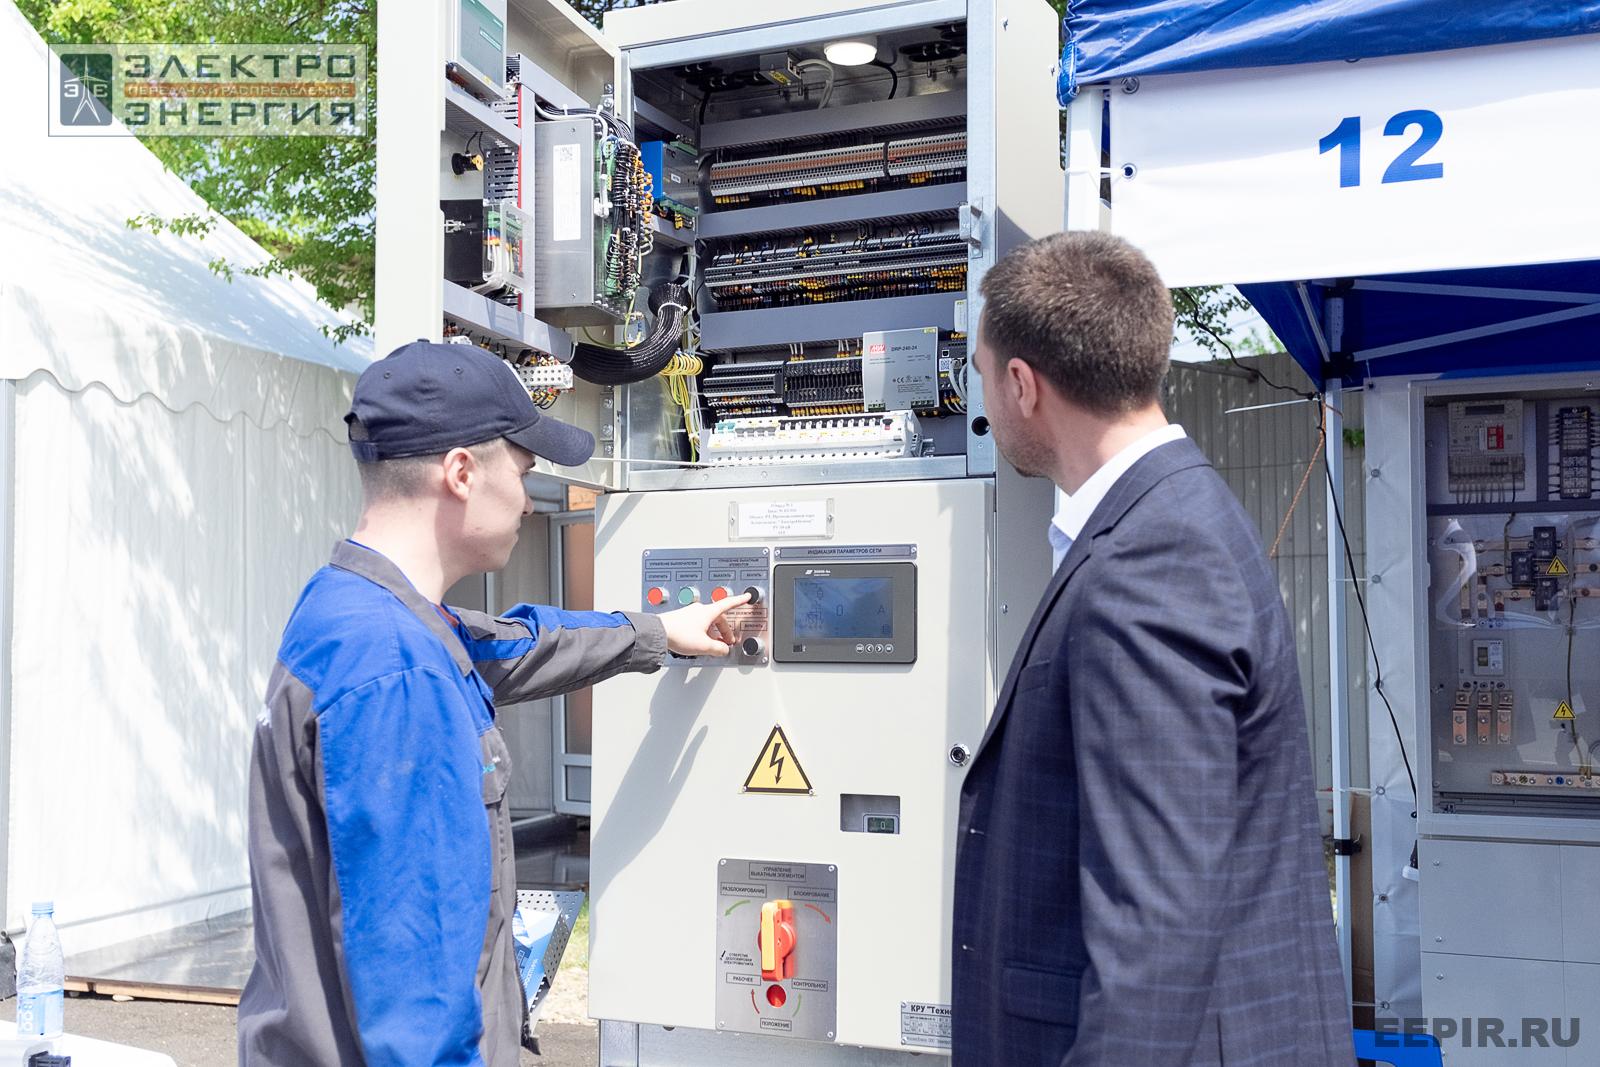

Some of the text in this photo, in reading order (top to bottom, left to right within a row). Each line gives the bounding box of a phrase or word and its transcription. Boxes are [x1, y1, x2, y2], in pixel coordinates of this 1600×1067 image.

[1319, 109, 1443, 188] 12
[722, 884, 765, 894] РАЗБЛОКИРОВАНИЕ
[793, 890, 830, 898] БЛОКИРОВАНИЕ
[732, 975, 753, 983] РАБОЧЕЕ
[793, 981, 827, 990] КОНТРОЛЬНОЕ
[911, 1004, 926, 1013] КРУ
[761, 1020, 790, 1030] ПОЛОЖЕНИЕ
